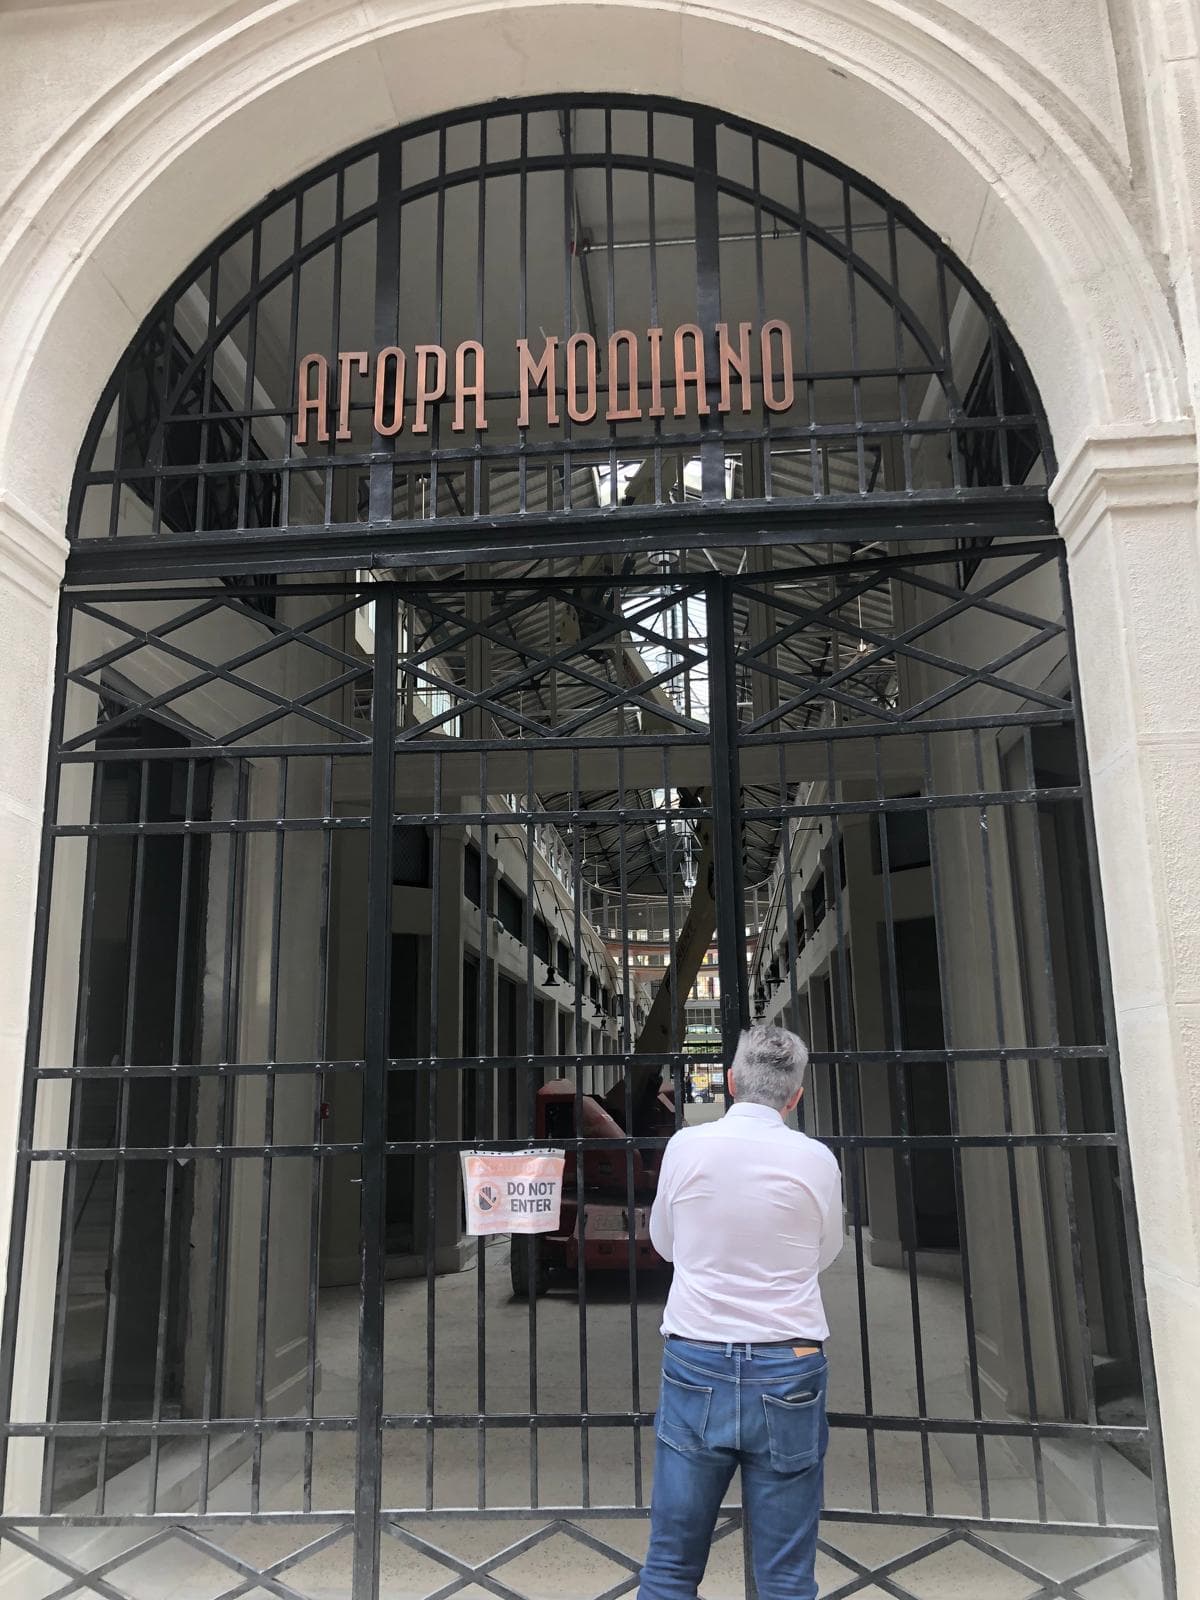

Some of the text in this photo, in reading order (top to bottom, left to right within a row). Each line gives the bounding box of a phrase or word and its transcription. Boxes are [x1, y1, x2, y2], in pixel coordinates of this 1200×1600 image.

[294, 319, 795, 443] ΑΓΟΡΑ ΜΟΔΙΑΝΟ
[507, 1182, 555, 1196] DO NOT
[510, 1199, 552, 1213] ENTER
